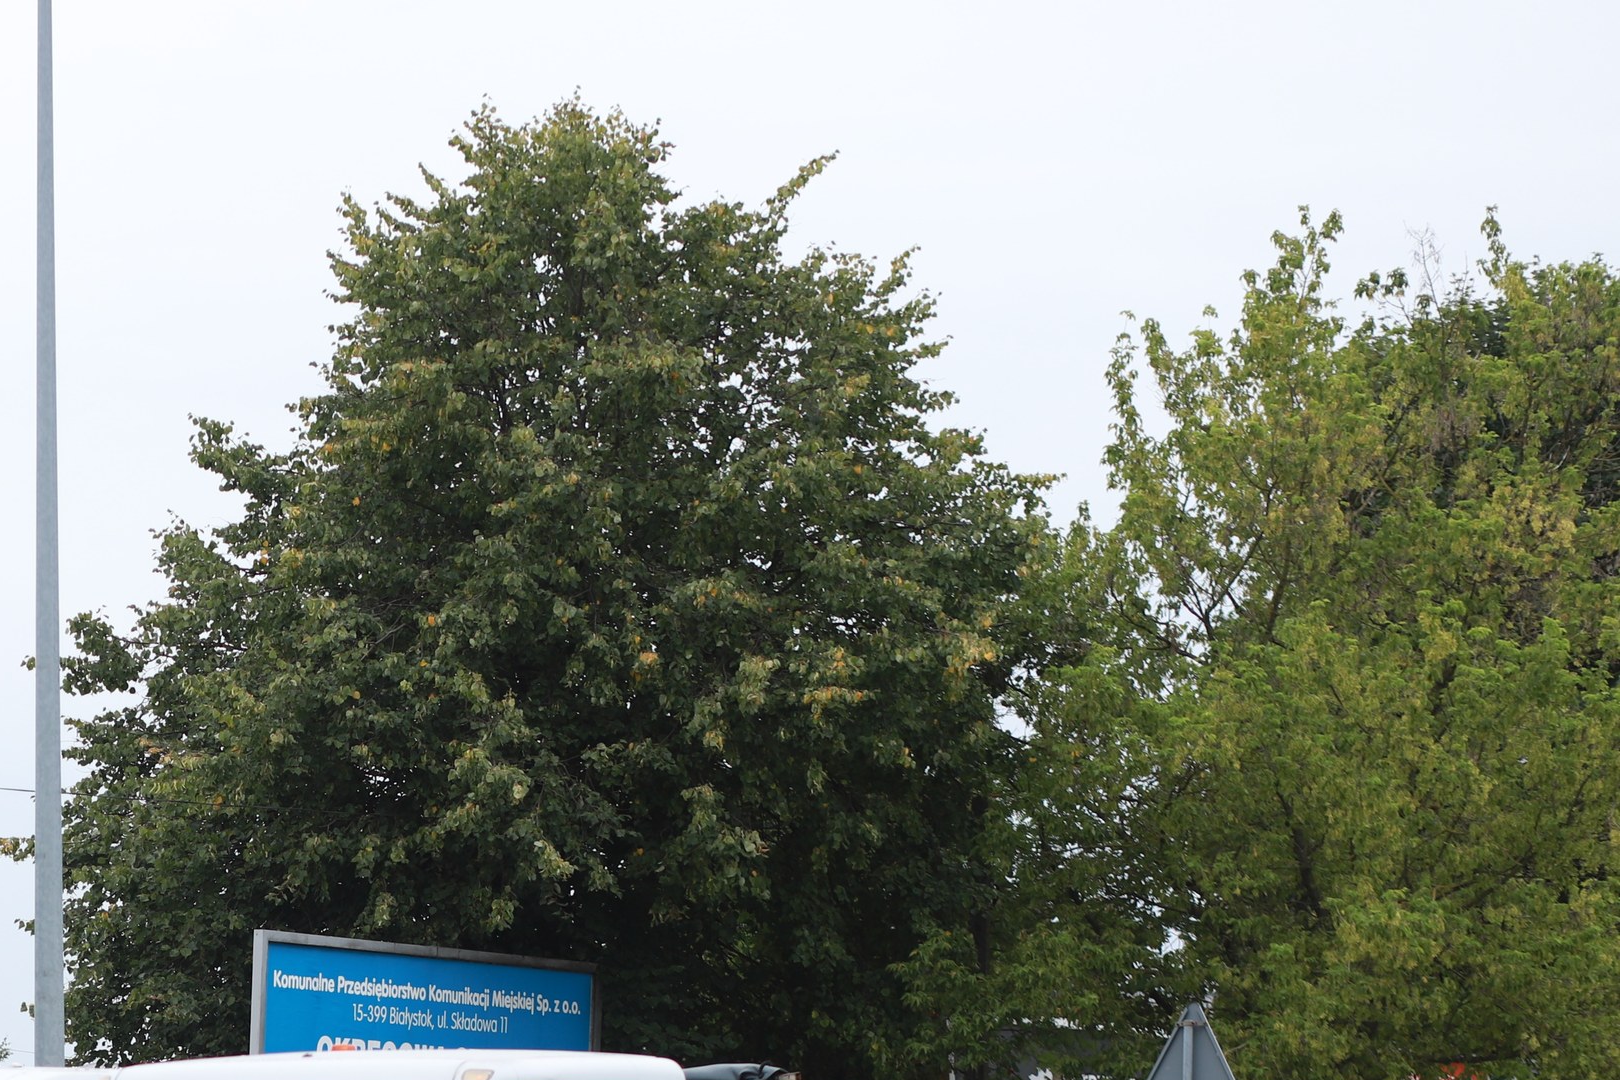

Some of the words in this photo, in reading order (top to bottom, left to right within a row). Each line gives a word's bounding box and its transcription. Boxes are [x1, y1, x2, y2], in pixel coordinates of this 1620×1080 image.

[273, 969, 334, 993] Komunalne
[337, 975, 426, 1001] Przedsiębiorstwo
[429, 983, 490, 1011] Komunikacji
[492, 989, 534, 1015] Miejskiej
[536, 994, 552, 1016] Sp.
[554, 999, 561, 1013] z
[562, 1000, 581, 1015] o.o.
[352, 1003, 387, 1024] 15-399
[389, 1006, 435, 1030] Białystok,
[437, 1011, 449, 1029] ul.
[451, 1011, 497, 1033] Składowa
[500, 1016, 508, 1034] 11
